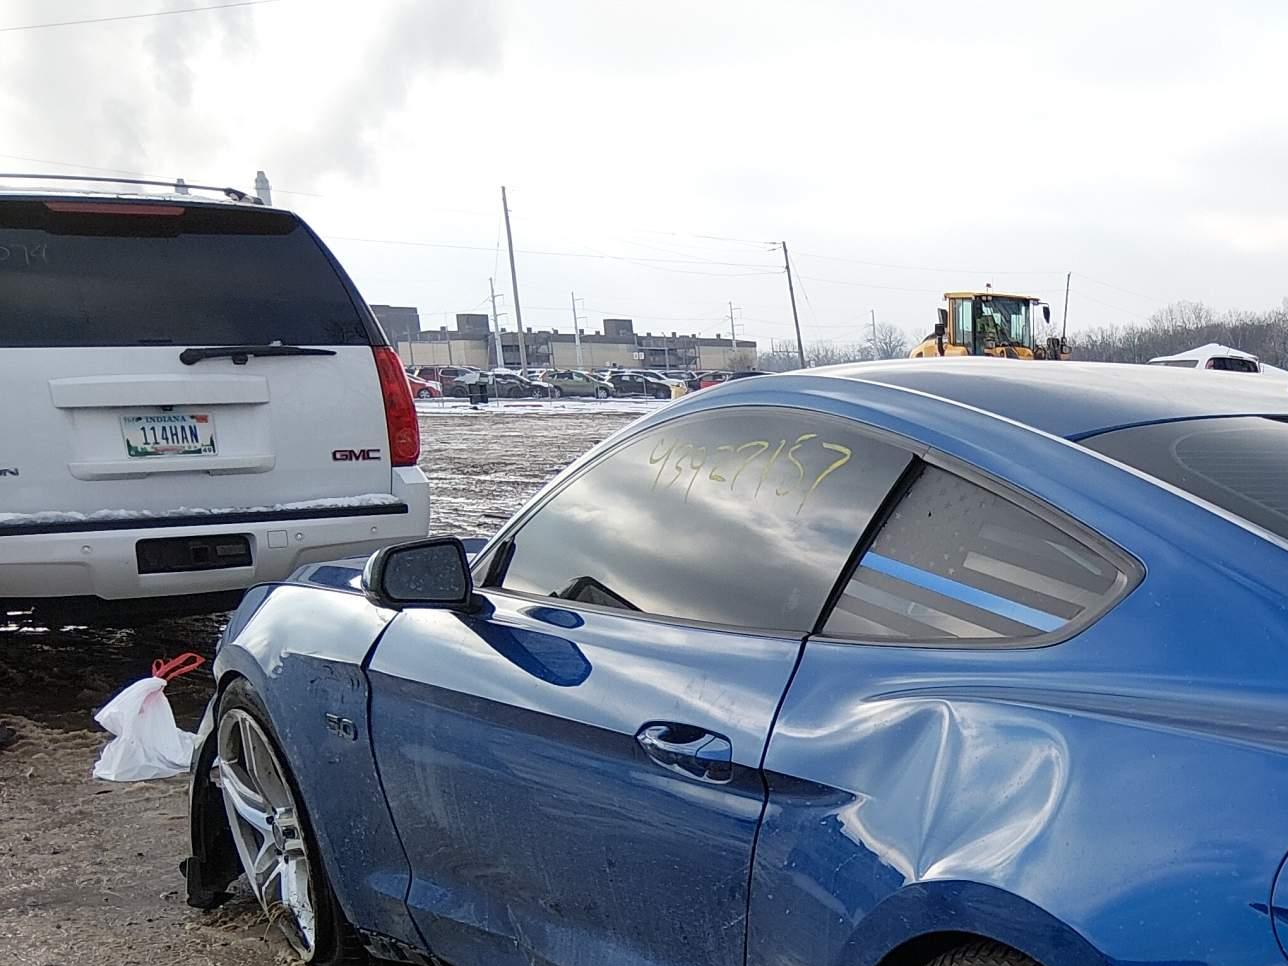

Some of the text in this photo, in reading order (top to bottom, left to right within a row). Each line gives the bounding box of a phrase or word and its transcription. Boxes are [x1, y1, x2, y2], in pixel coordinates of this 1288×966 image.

[144, 415, 187, 423] INDIANA
[140, 424, 199, 446] 114HAN
[332, 448, 381, 461] GMC
